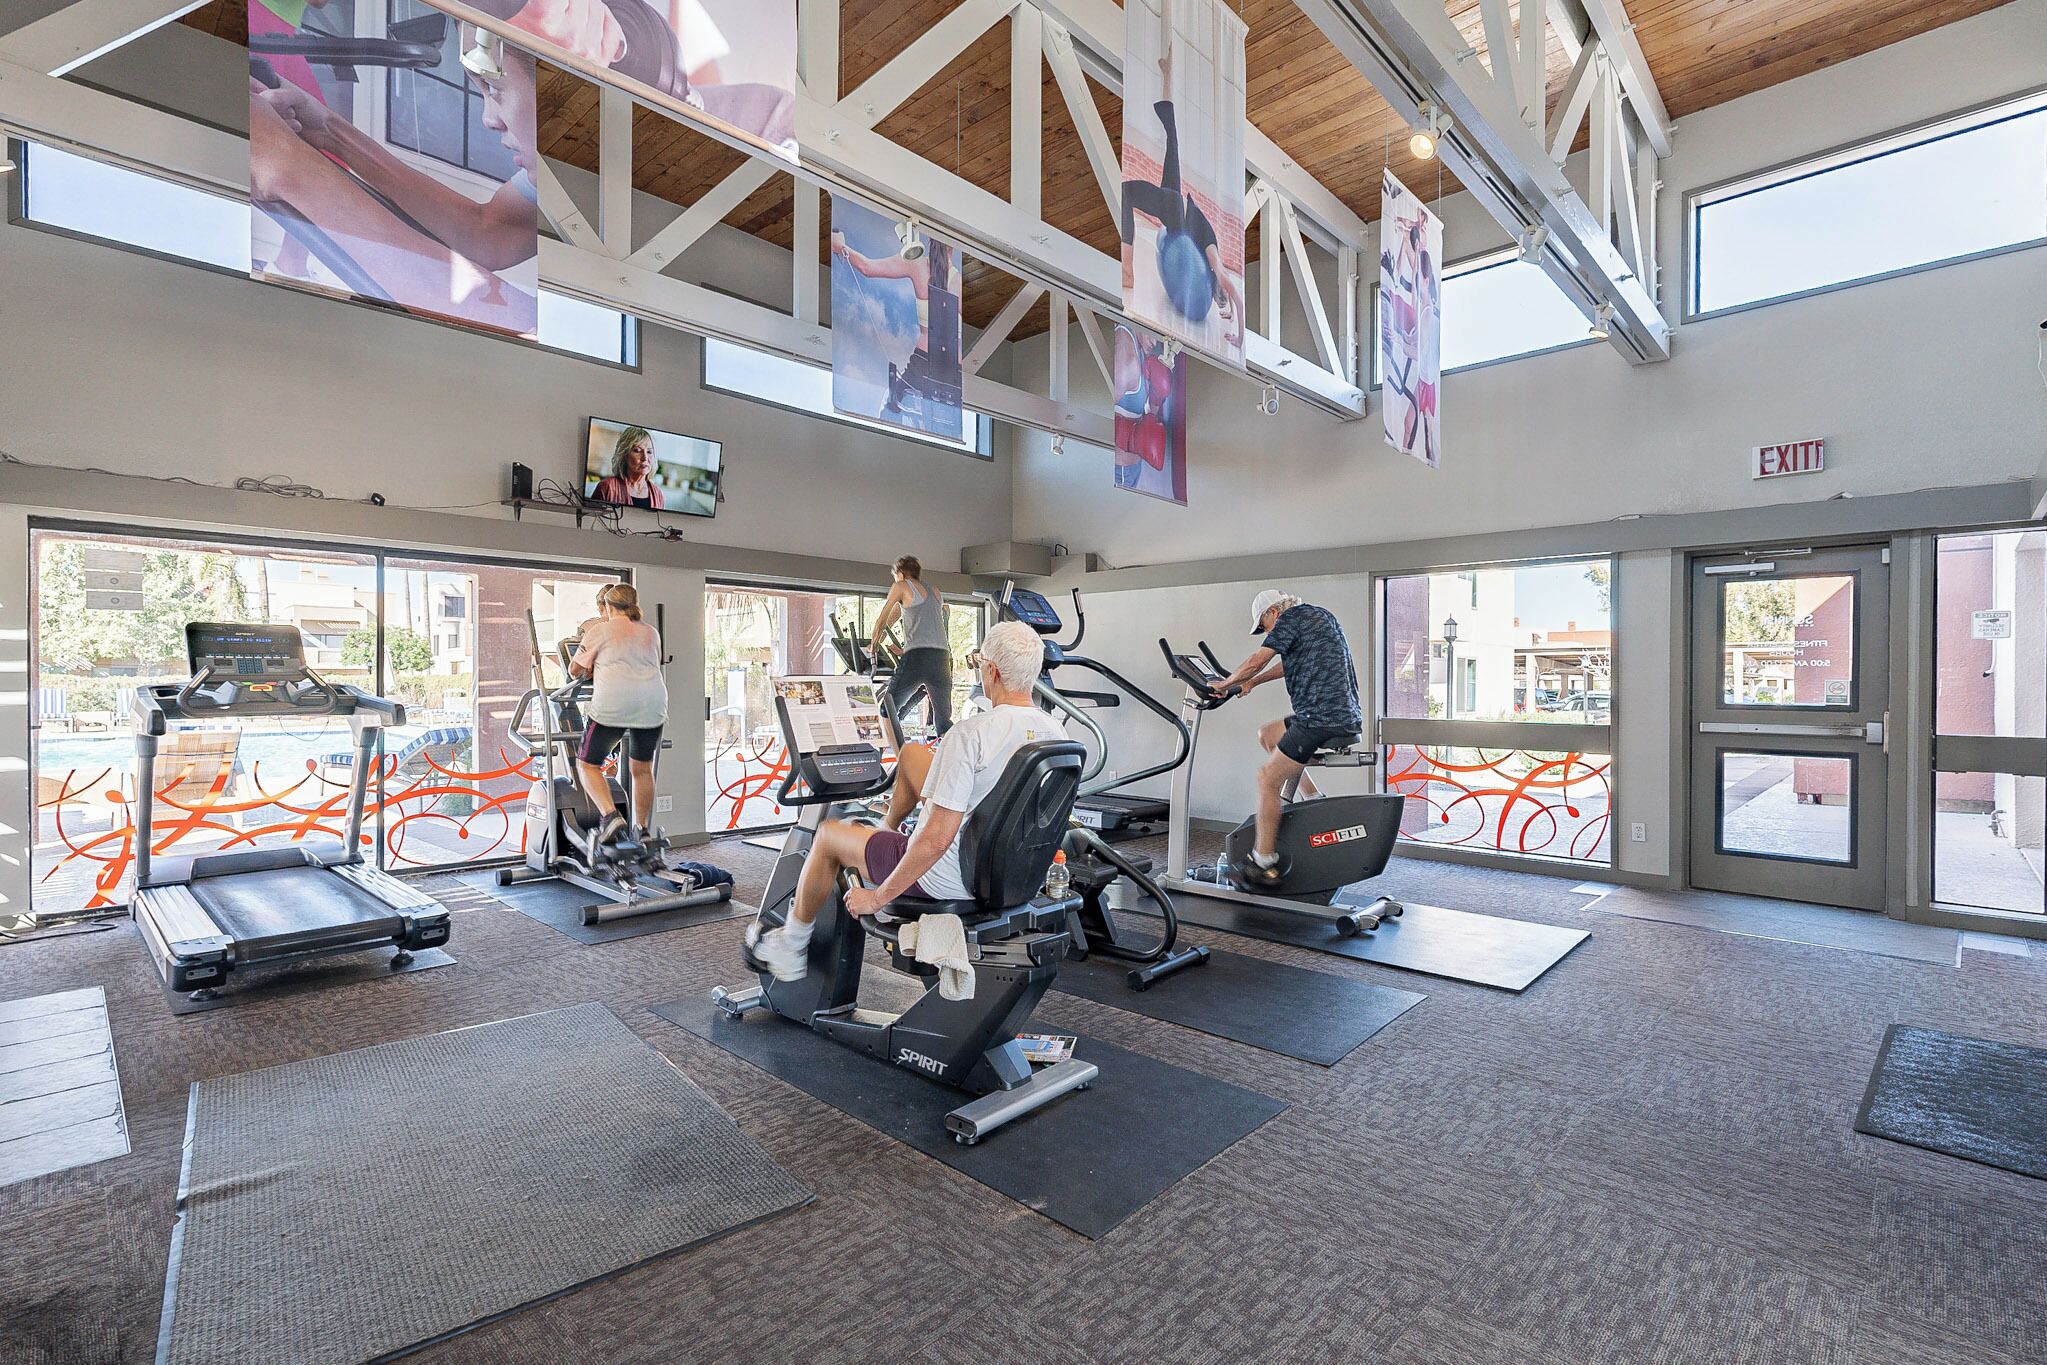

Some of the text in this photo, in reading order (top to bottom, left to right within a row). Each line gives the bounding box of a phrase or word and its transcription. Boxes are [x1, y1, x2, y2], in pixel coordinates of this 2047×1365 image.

[1760, 441, 1814, 476] EXIT
[1312, 827, 1364, 846] SCIFIT
[897, 1047, 949, 1076] SPIRIT
